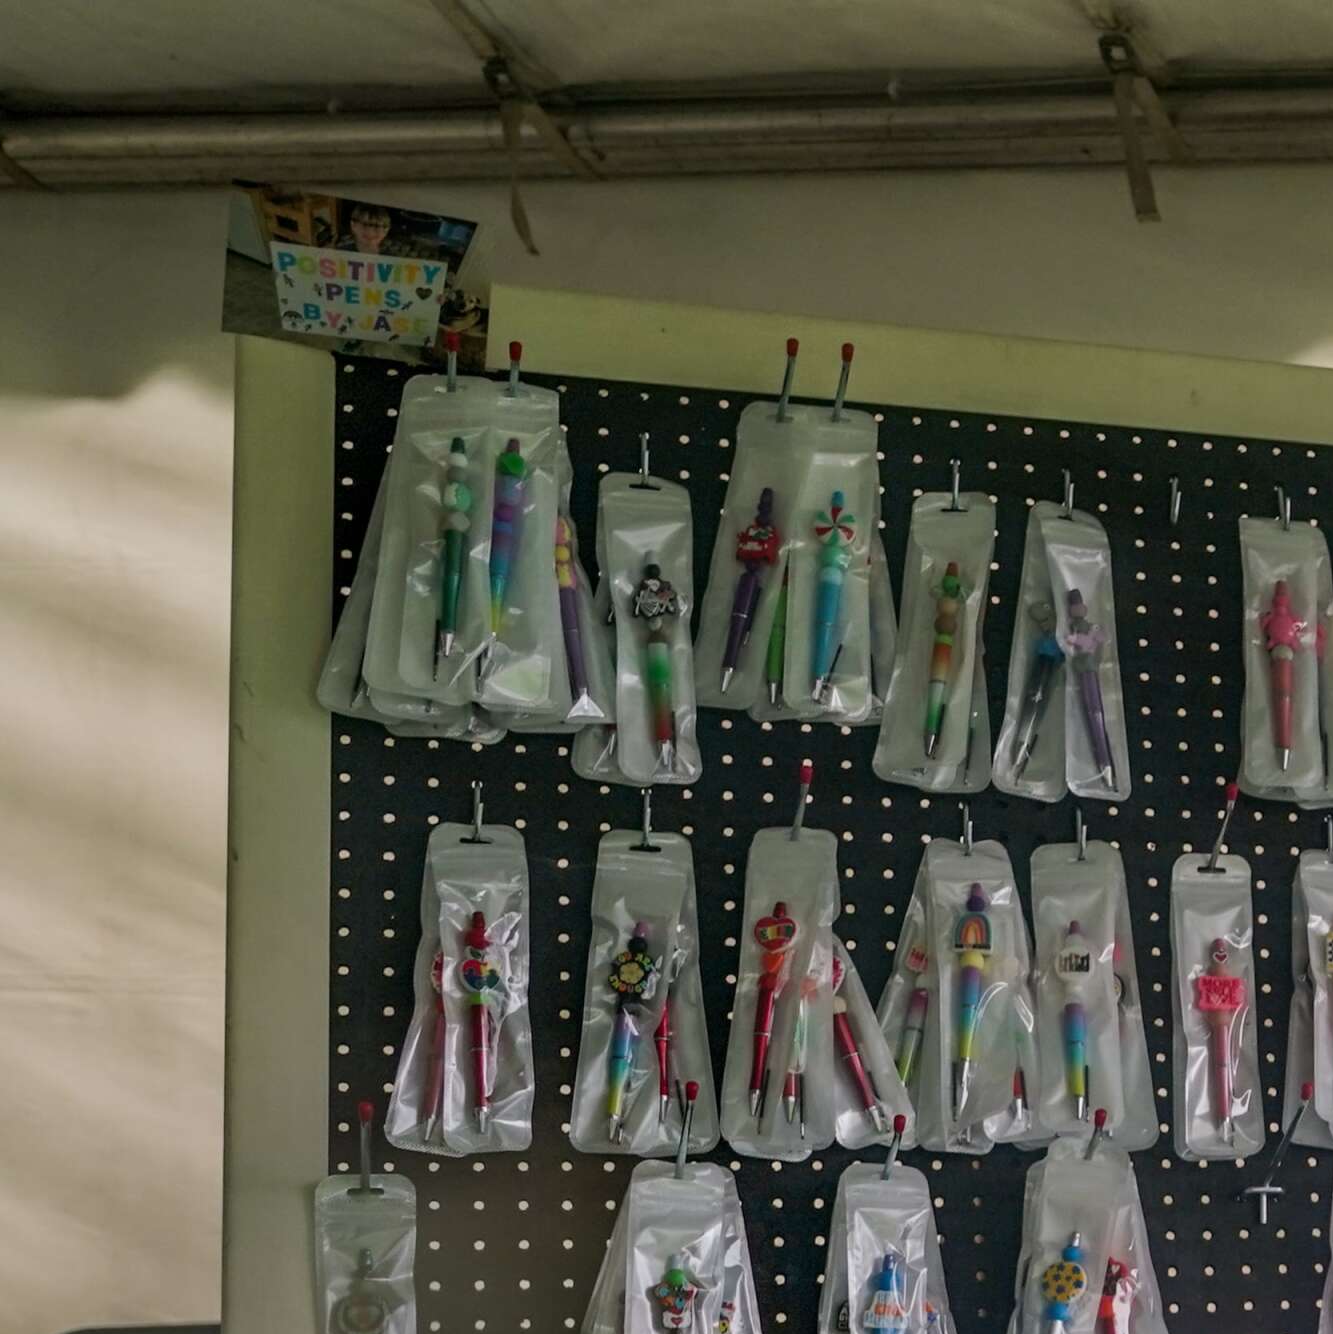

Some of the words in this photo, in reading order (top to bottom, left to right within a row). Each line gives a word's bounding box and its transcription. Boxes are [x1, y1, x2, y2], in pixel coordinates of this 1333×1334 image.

[277, 251, 441, 285] POSITIVITY
[325, 283, 402, 308] PENS
[303, 303, 345, 329] BY
[358, 315, 429, 335] JASE
